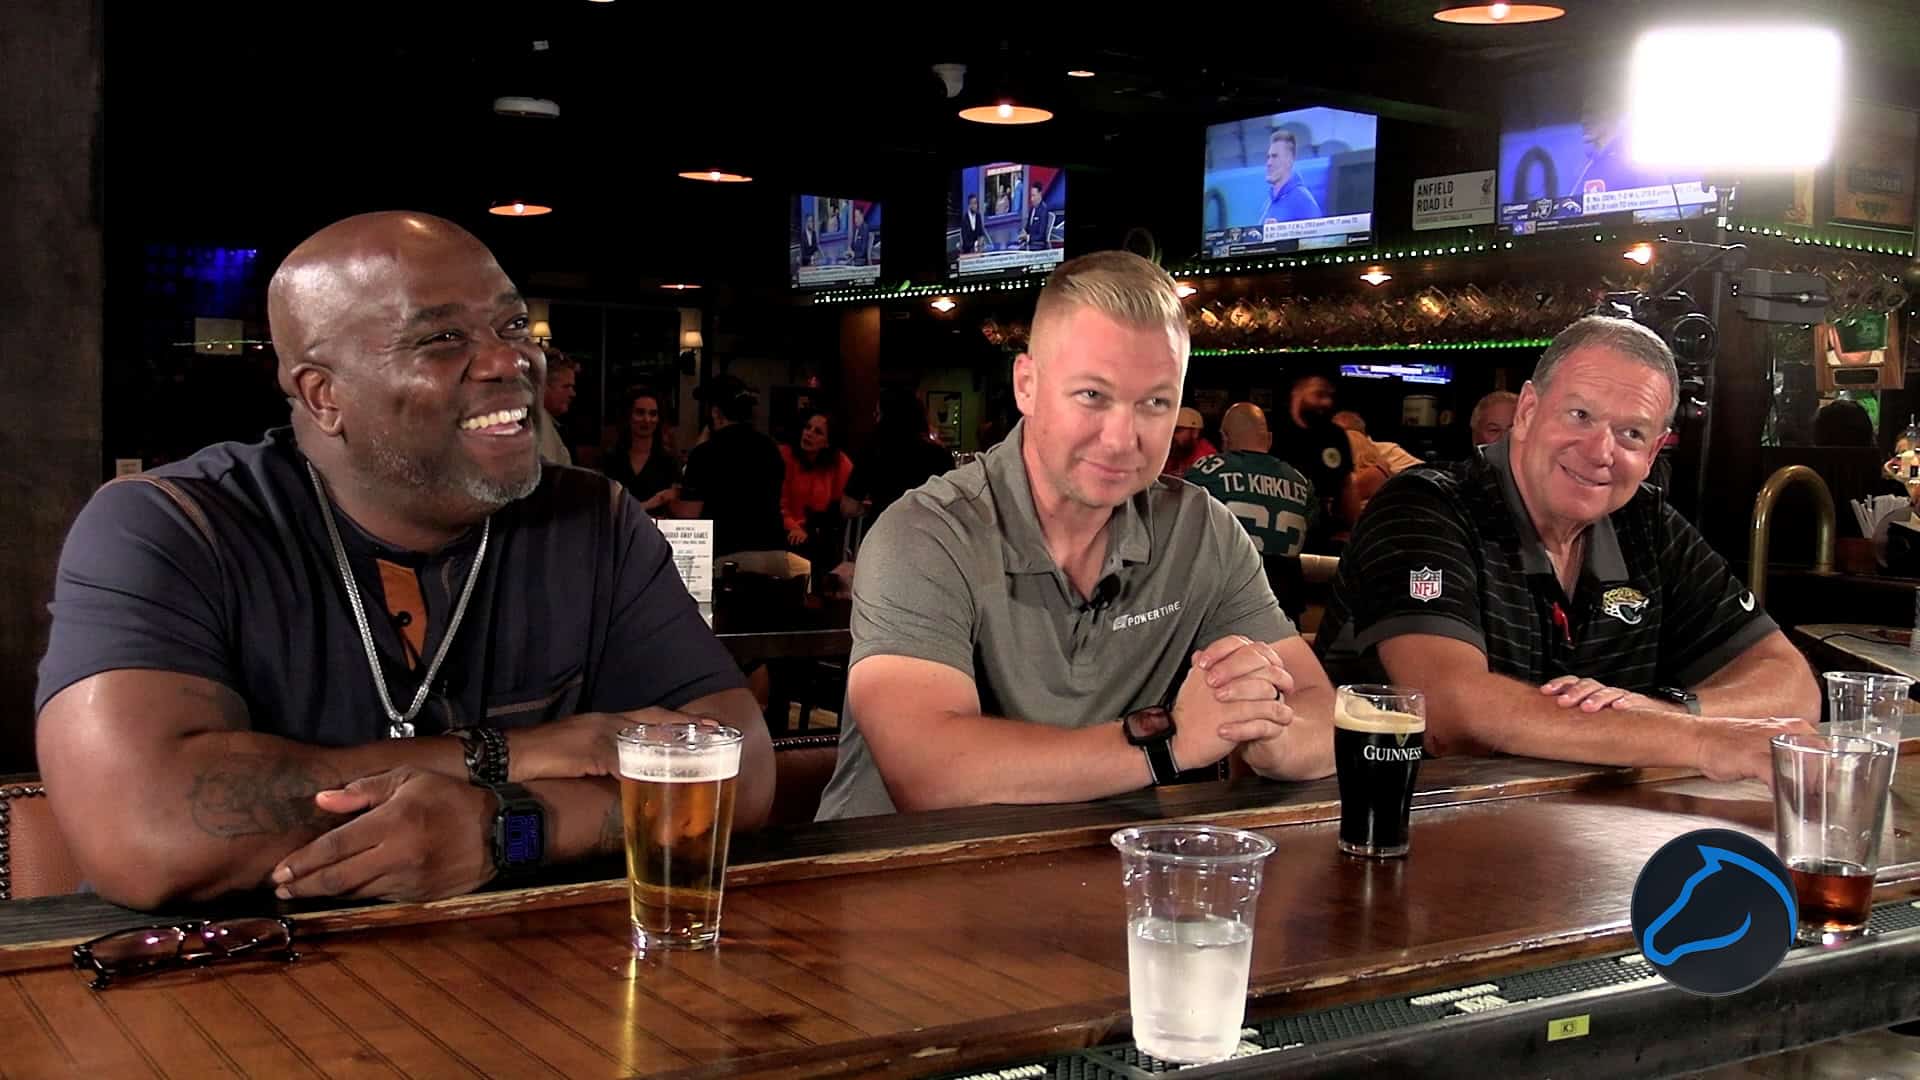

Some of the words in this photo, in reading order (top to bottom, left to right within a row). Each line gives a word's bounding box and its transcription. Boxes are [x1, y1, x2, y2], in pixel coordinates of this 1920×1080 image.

[1417, 181, 1454, 197] ANFIELD
[1417, 198, 1440, 212] ROAD
[1443, 196, 1454, 209] L4
[1218, 472, 1245, 493] TC
[1413, 582, 1438, 596] NFL
